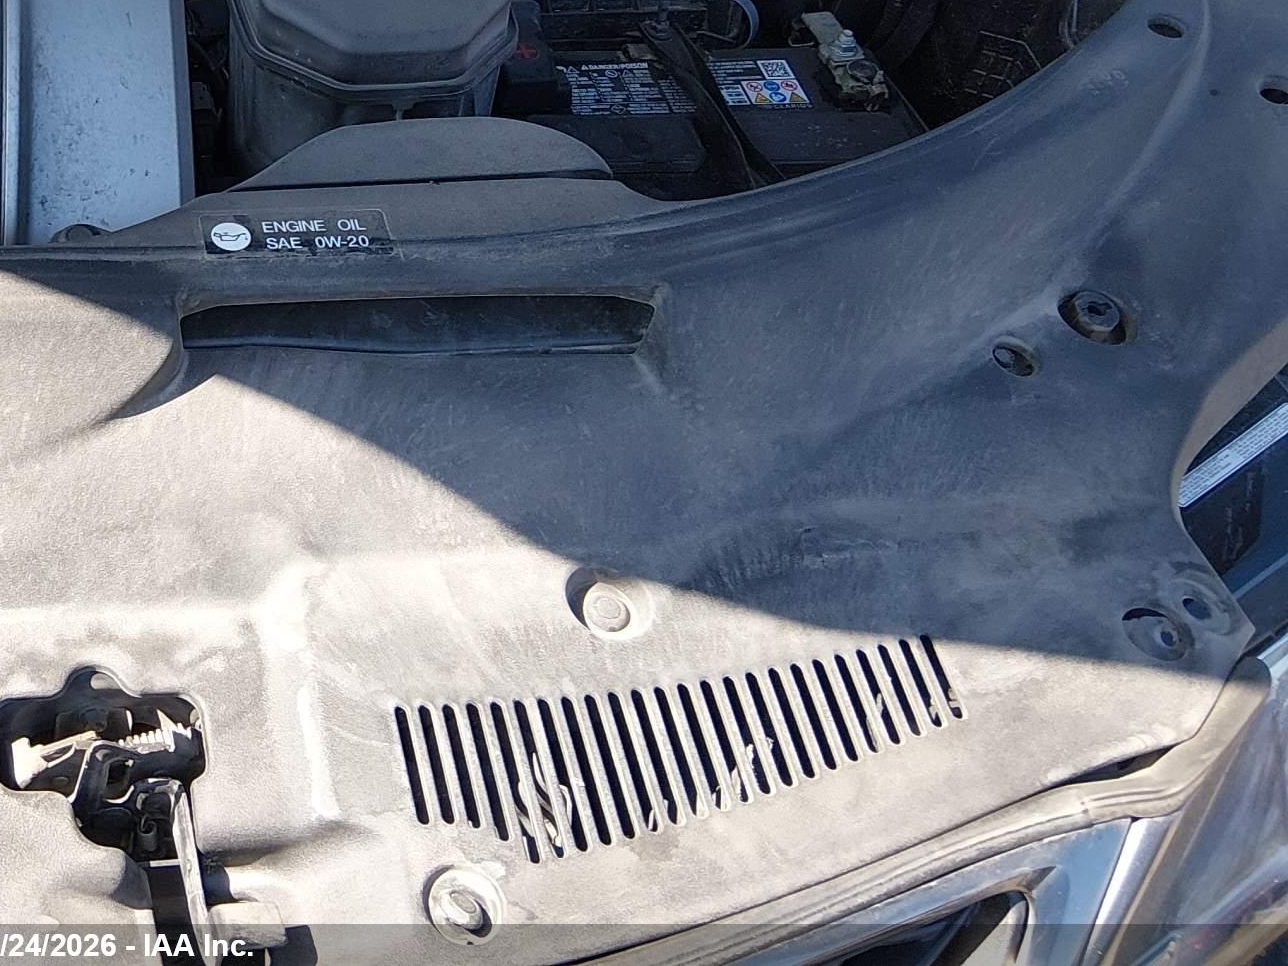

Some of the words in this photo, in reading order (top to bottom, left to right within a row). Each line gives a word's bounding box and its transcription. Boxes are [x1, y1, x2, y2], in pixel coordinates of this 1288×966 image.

[261, 219, 326, 233] ENGINE
[338, 218, 367, 231] OIL
[266, 236, 303, 250] SAE
[315, 235, 370, 249] 0W-20
